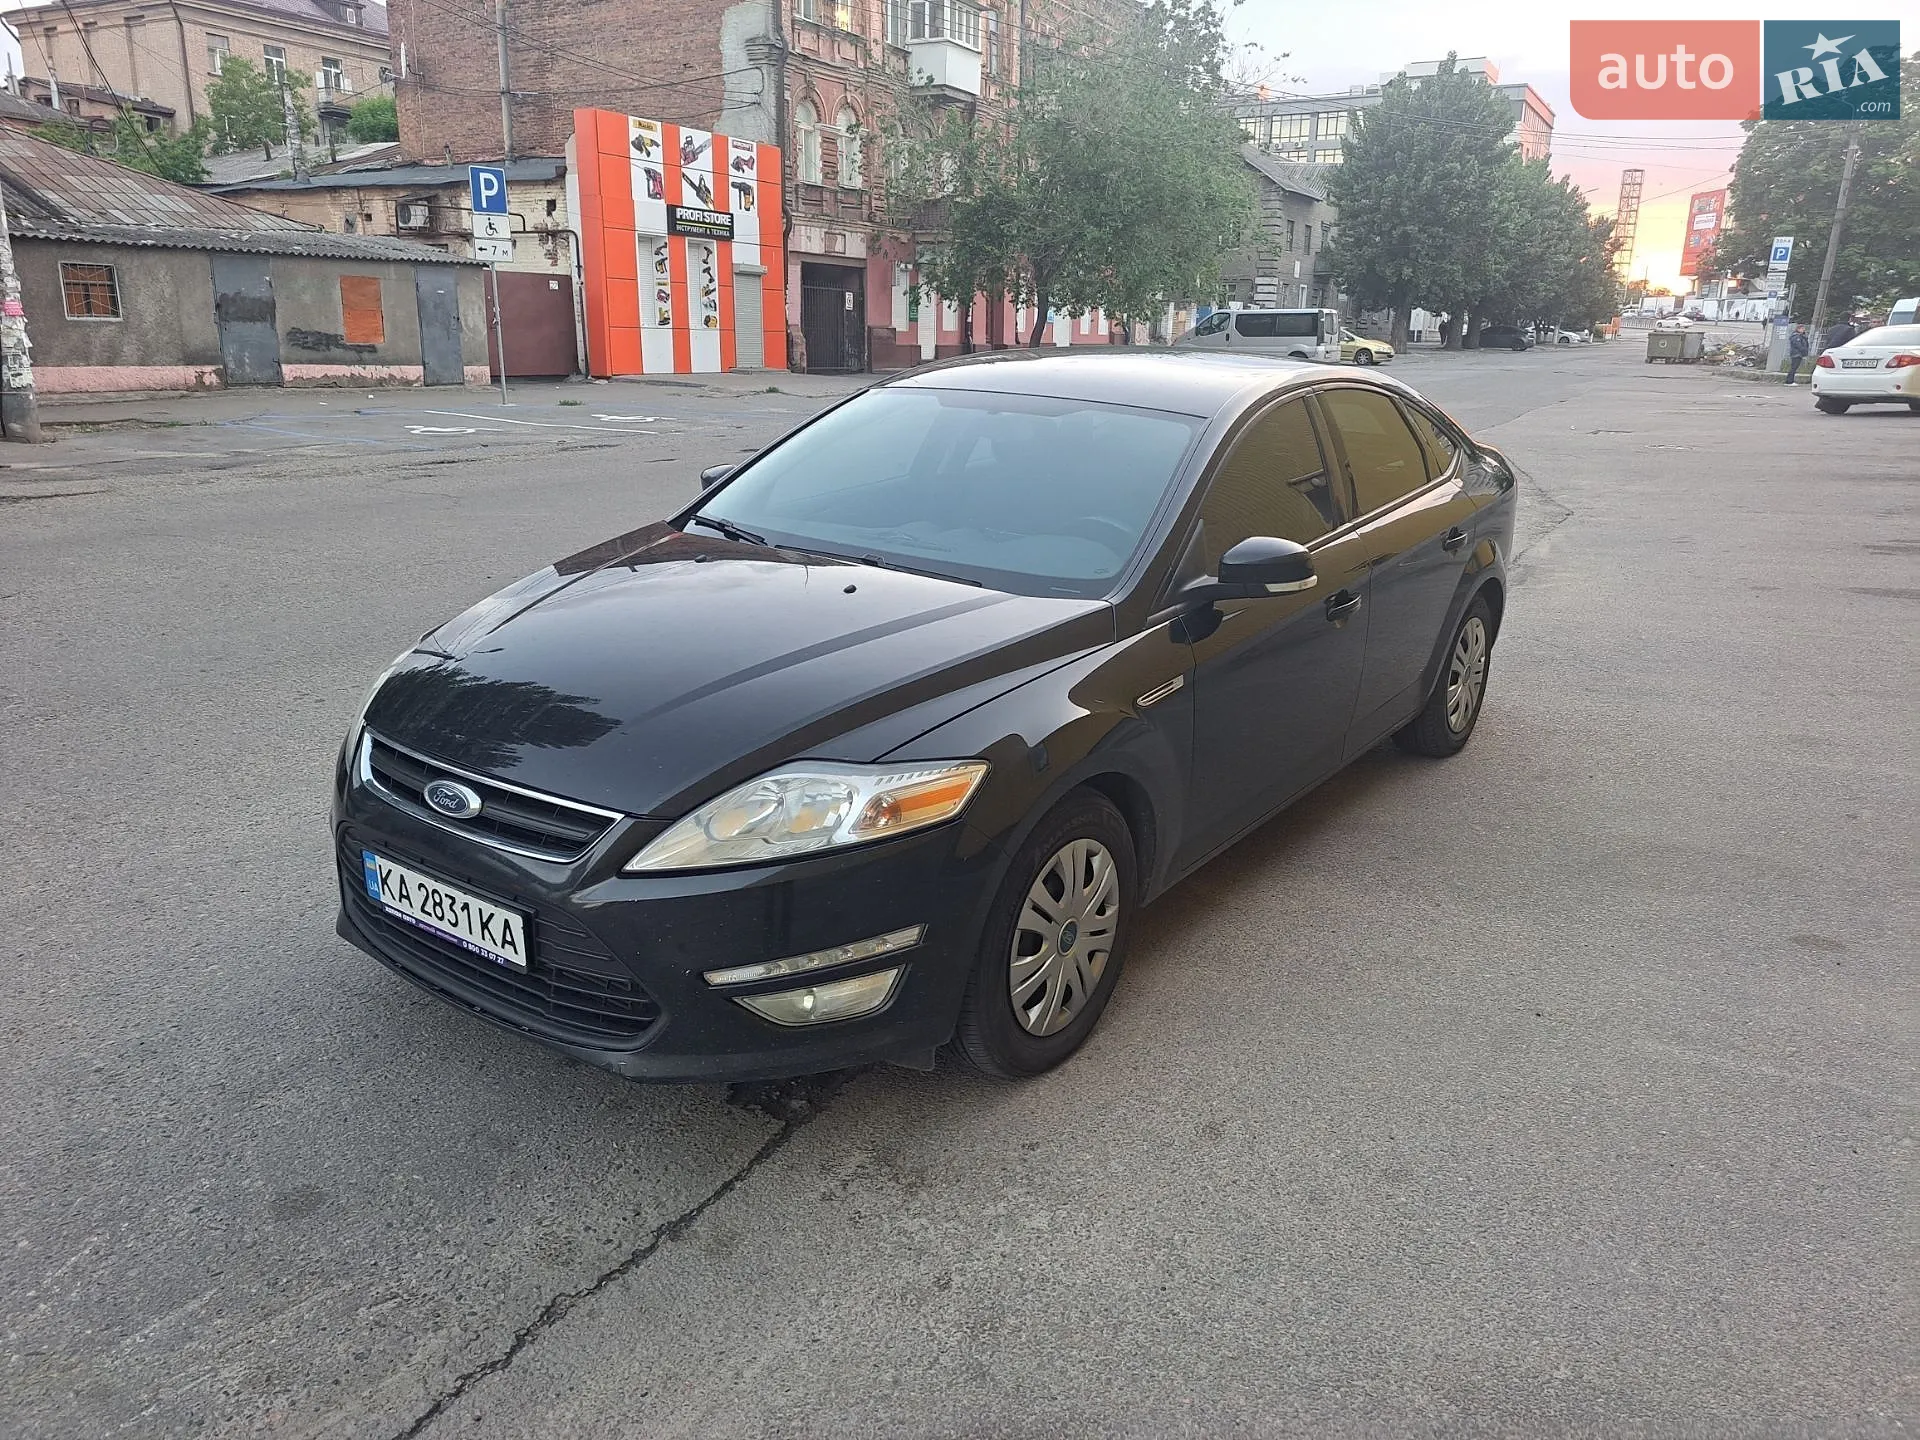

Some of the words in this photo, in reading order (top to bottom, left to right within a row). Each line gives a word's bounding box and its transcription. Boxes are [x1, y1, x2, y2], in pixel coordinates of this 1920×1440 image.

[479, 172, 499, 209] P
[675, 207, 703, 222] PROFI
[703, 211, 732, 226] STORE
[491, 245, 497, 255] 7
[1776, 248, 1786, 260] P
[433, 788, 460, 809] Ford
[368, 879, 379, 893] UA
[378, 864, 414, 909] KA
[417, 882, 473, 936] 2831
[478, 907, 519, 955] KA
